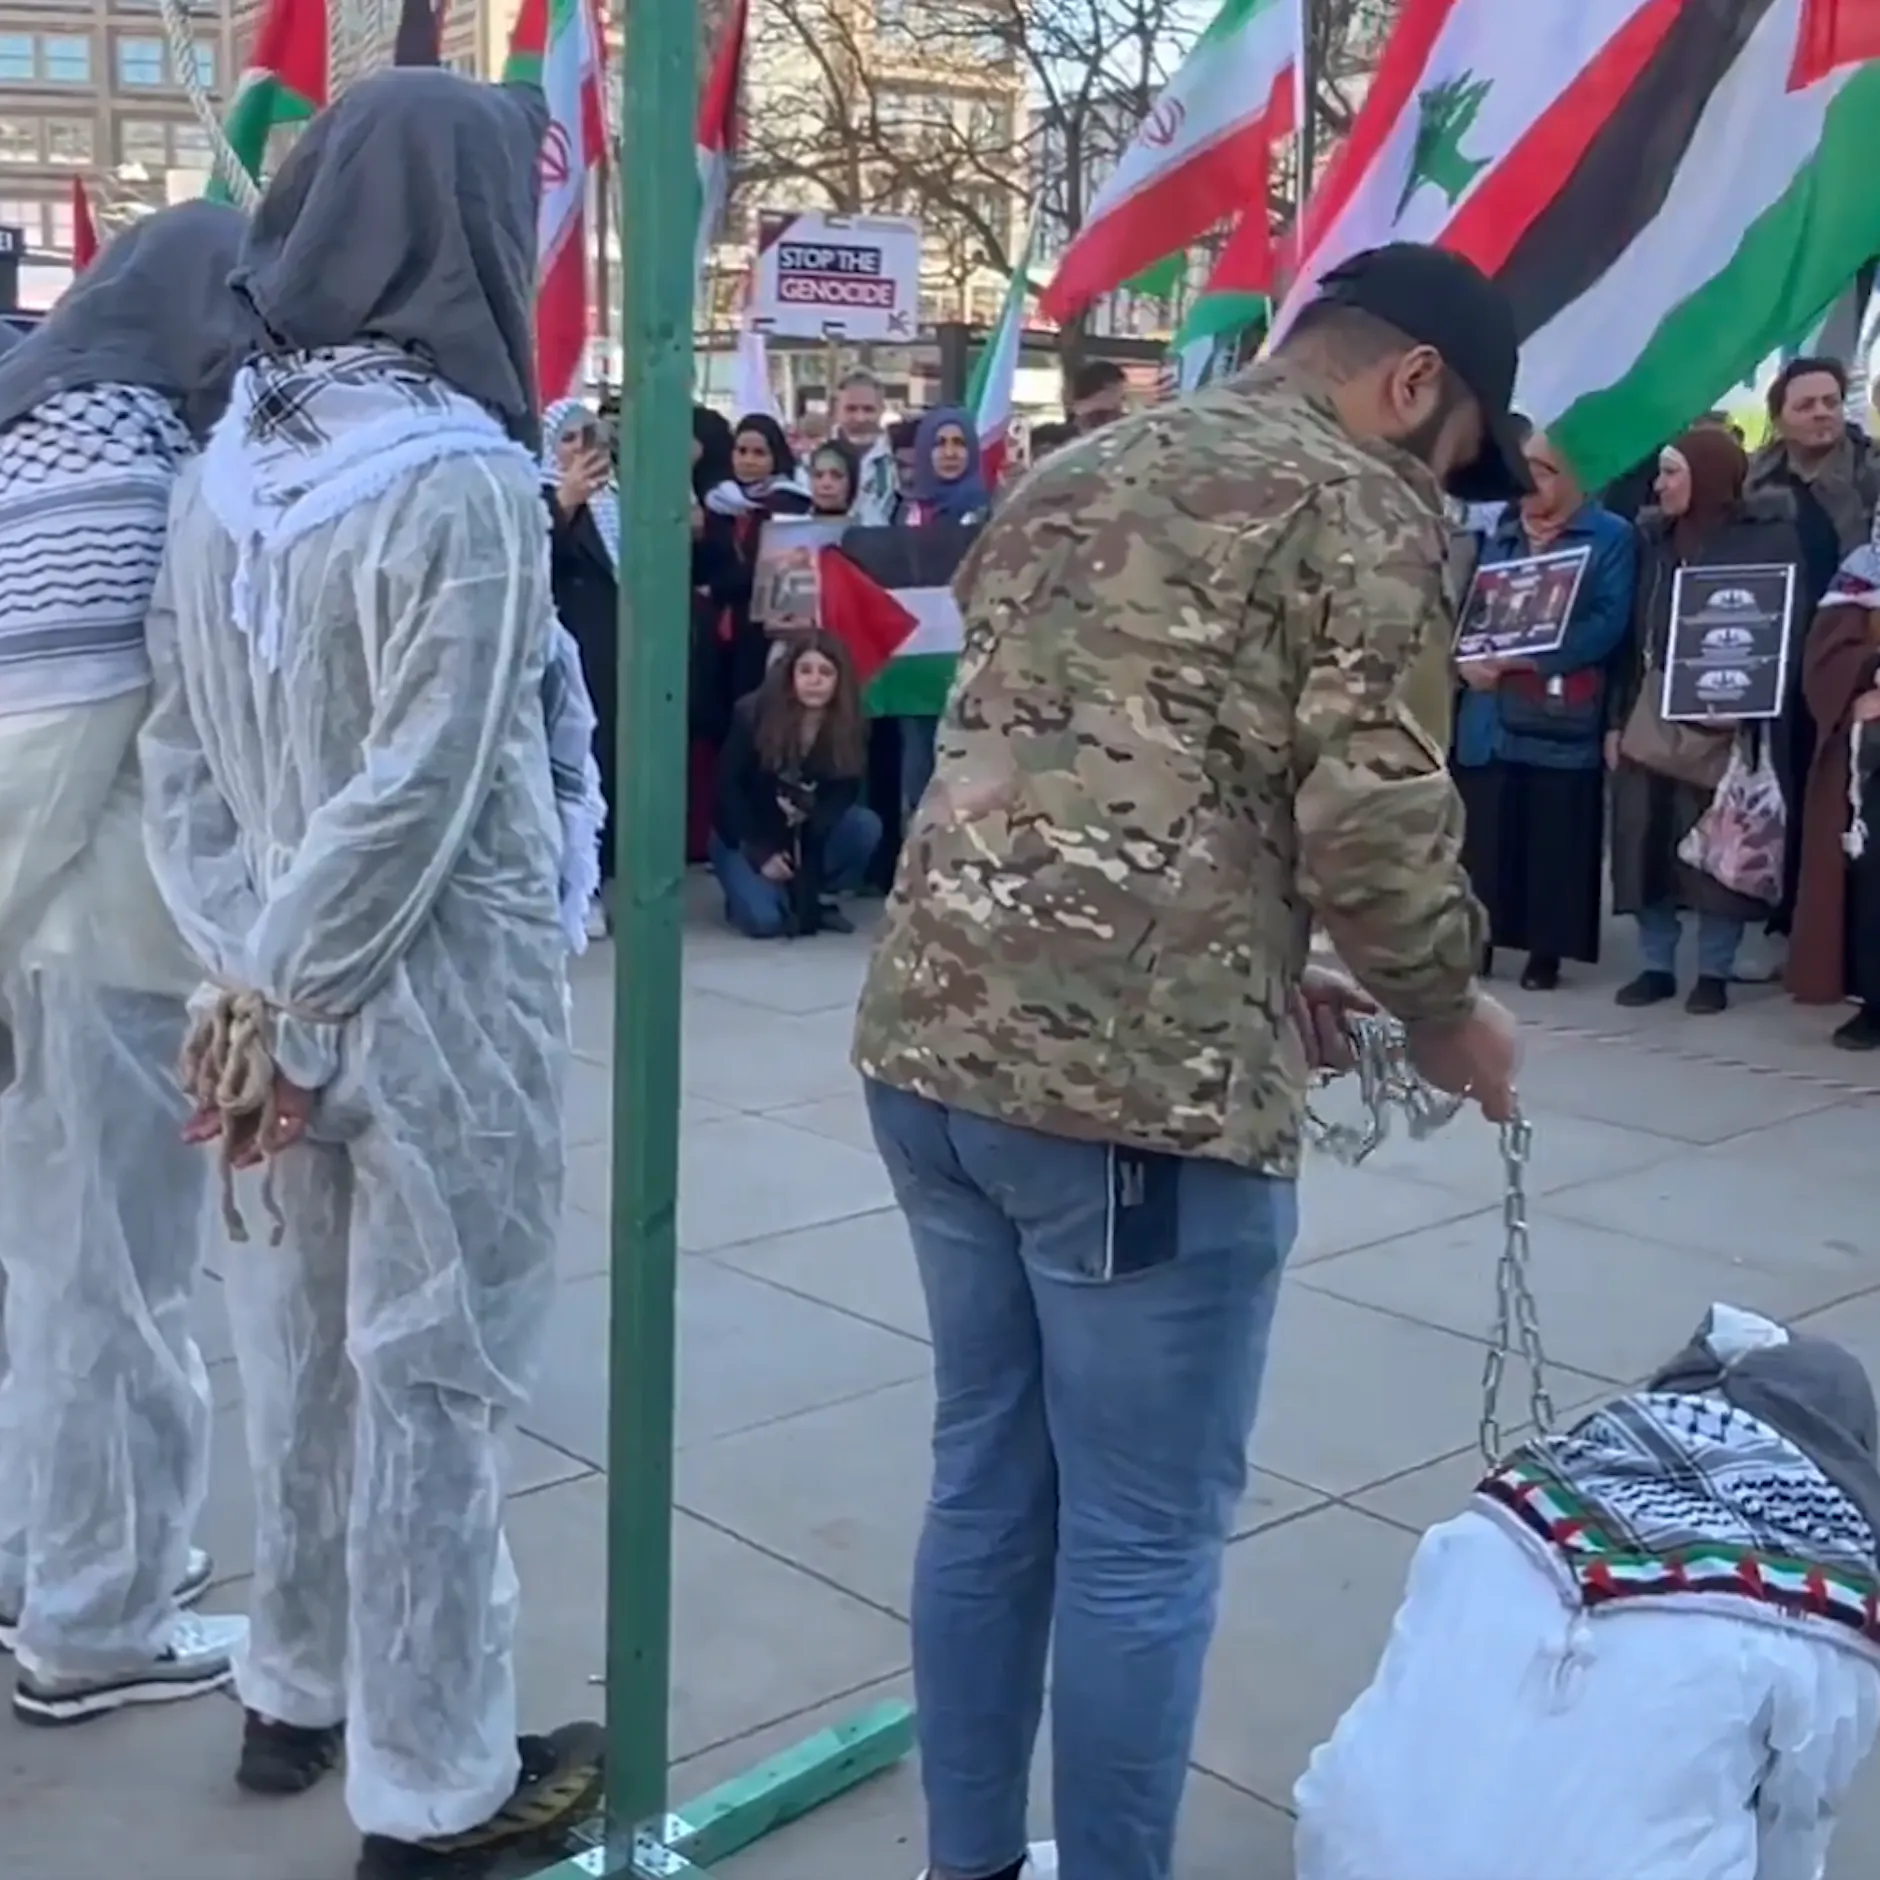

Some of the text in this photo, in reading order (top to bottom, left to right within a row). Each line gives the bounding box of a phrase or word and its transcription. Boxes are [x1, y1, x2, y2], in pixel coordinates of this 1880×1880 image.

[781, 248, 876, 271] STOP THE
[782, 278, 892, 304] GENOCIDE
